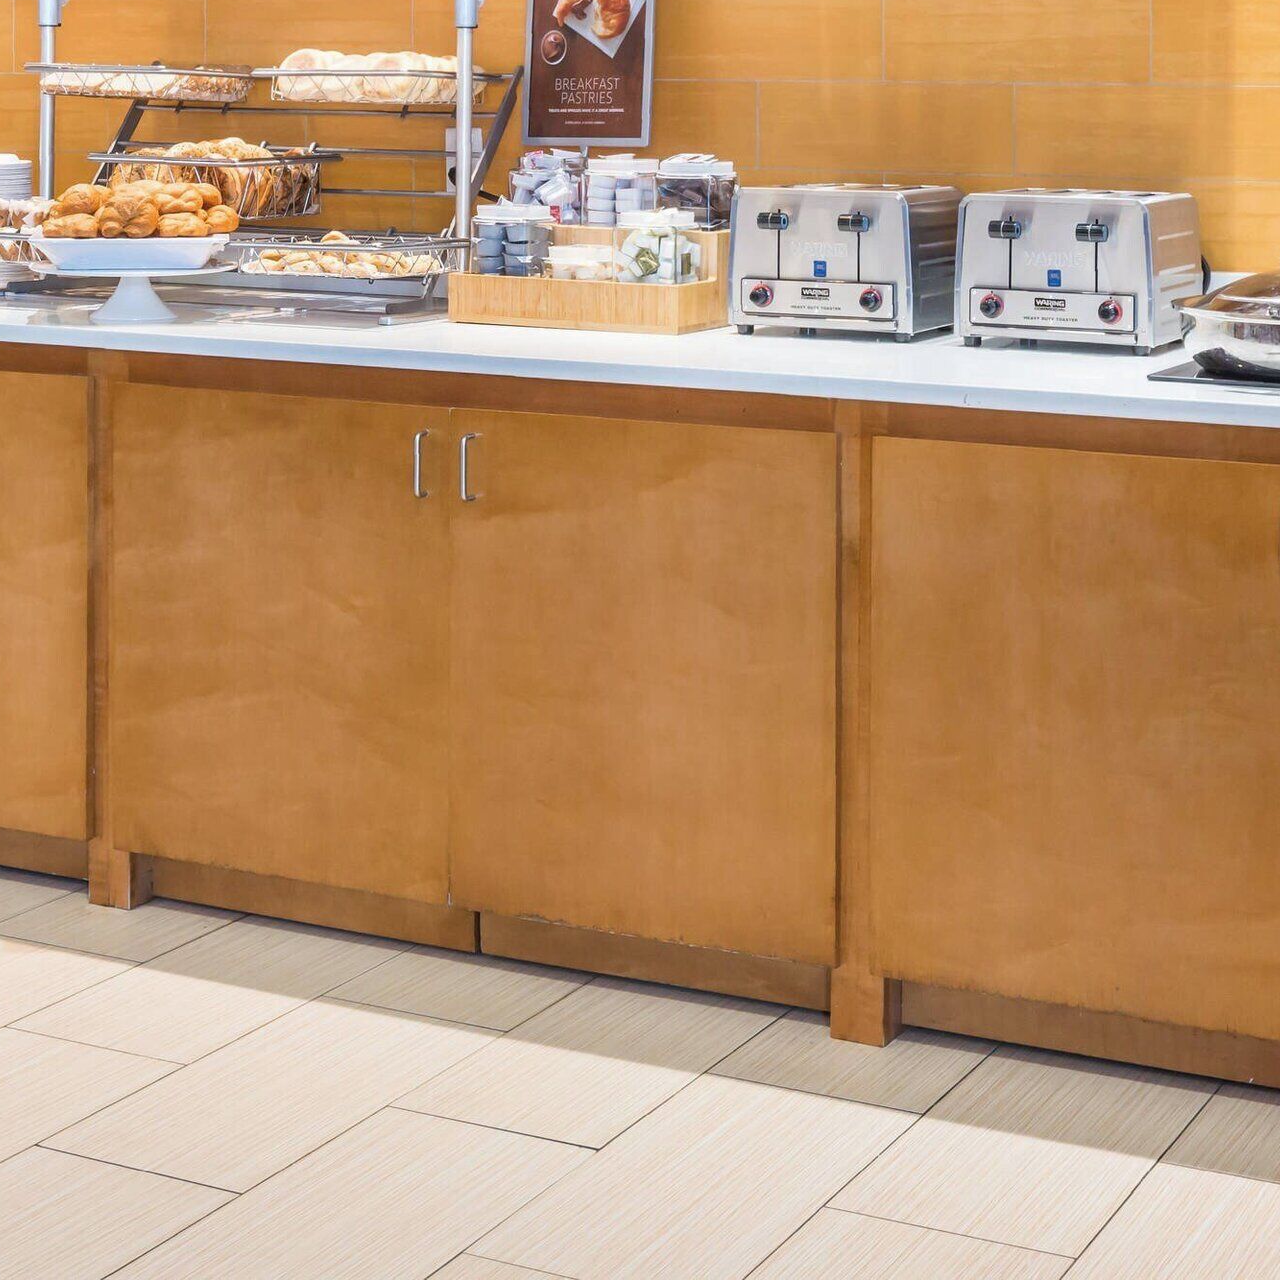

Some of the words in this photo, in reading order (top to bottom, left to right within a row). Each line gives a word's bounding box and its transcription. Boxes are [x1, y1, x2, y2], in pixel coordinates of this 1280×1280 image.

[554, 77, 620, 91] BREAKFAST
[561, 91, 613, 104] PASTRIES
[802, 288, 829, 297] WARING
[1035, 299, 1065, 307] WARING
